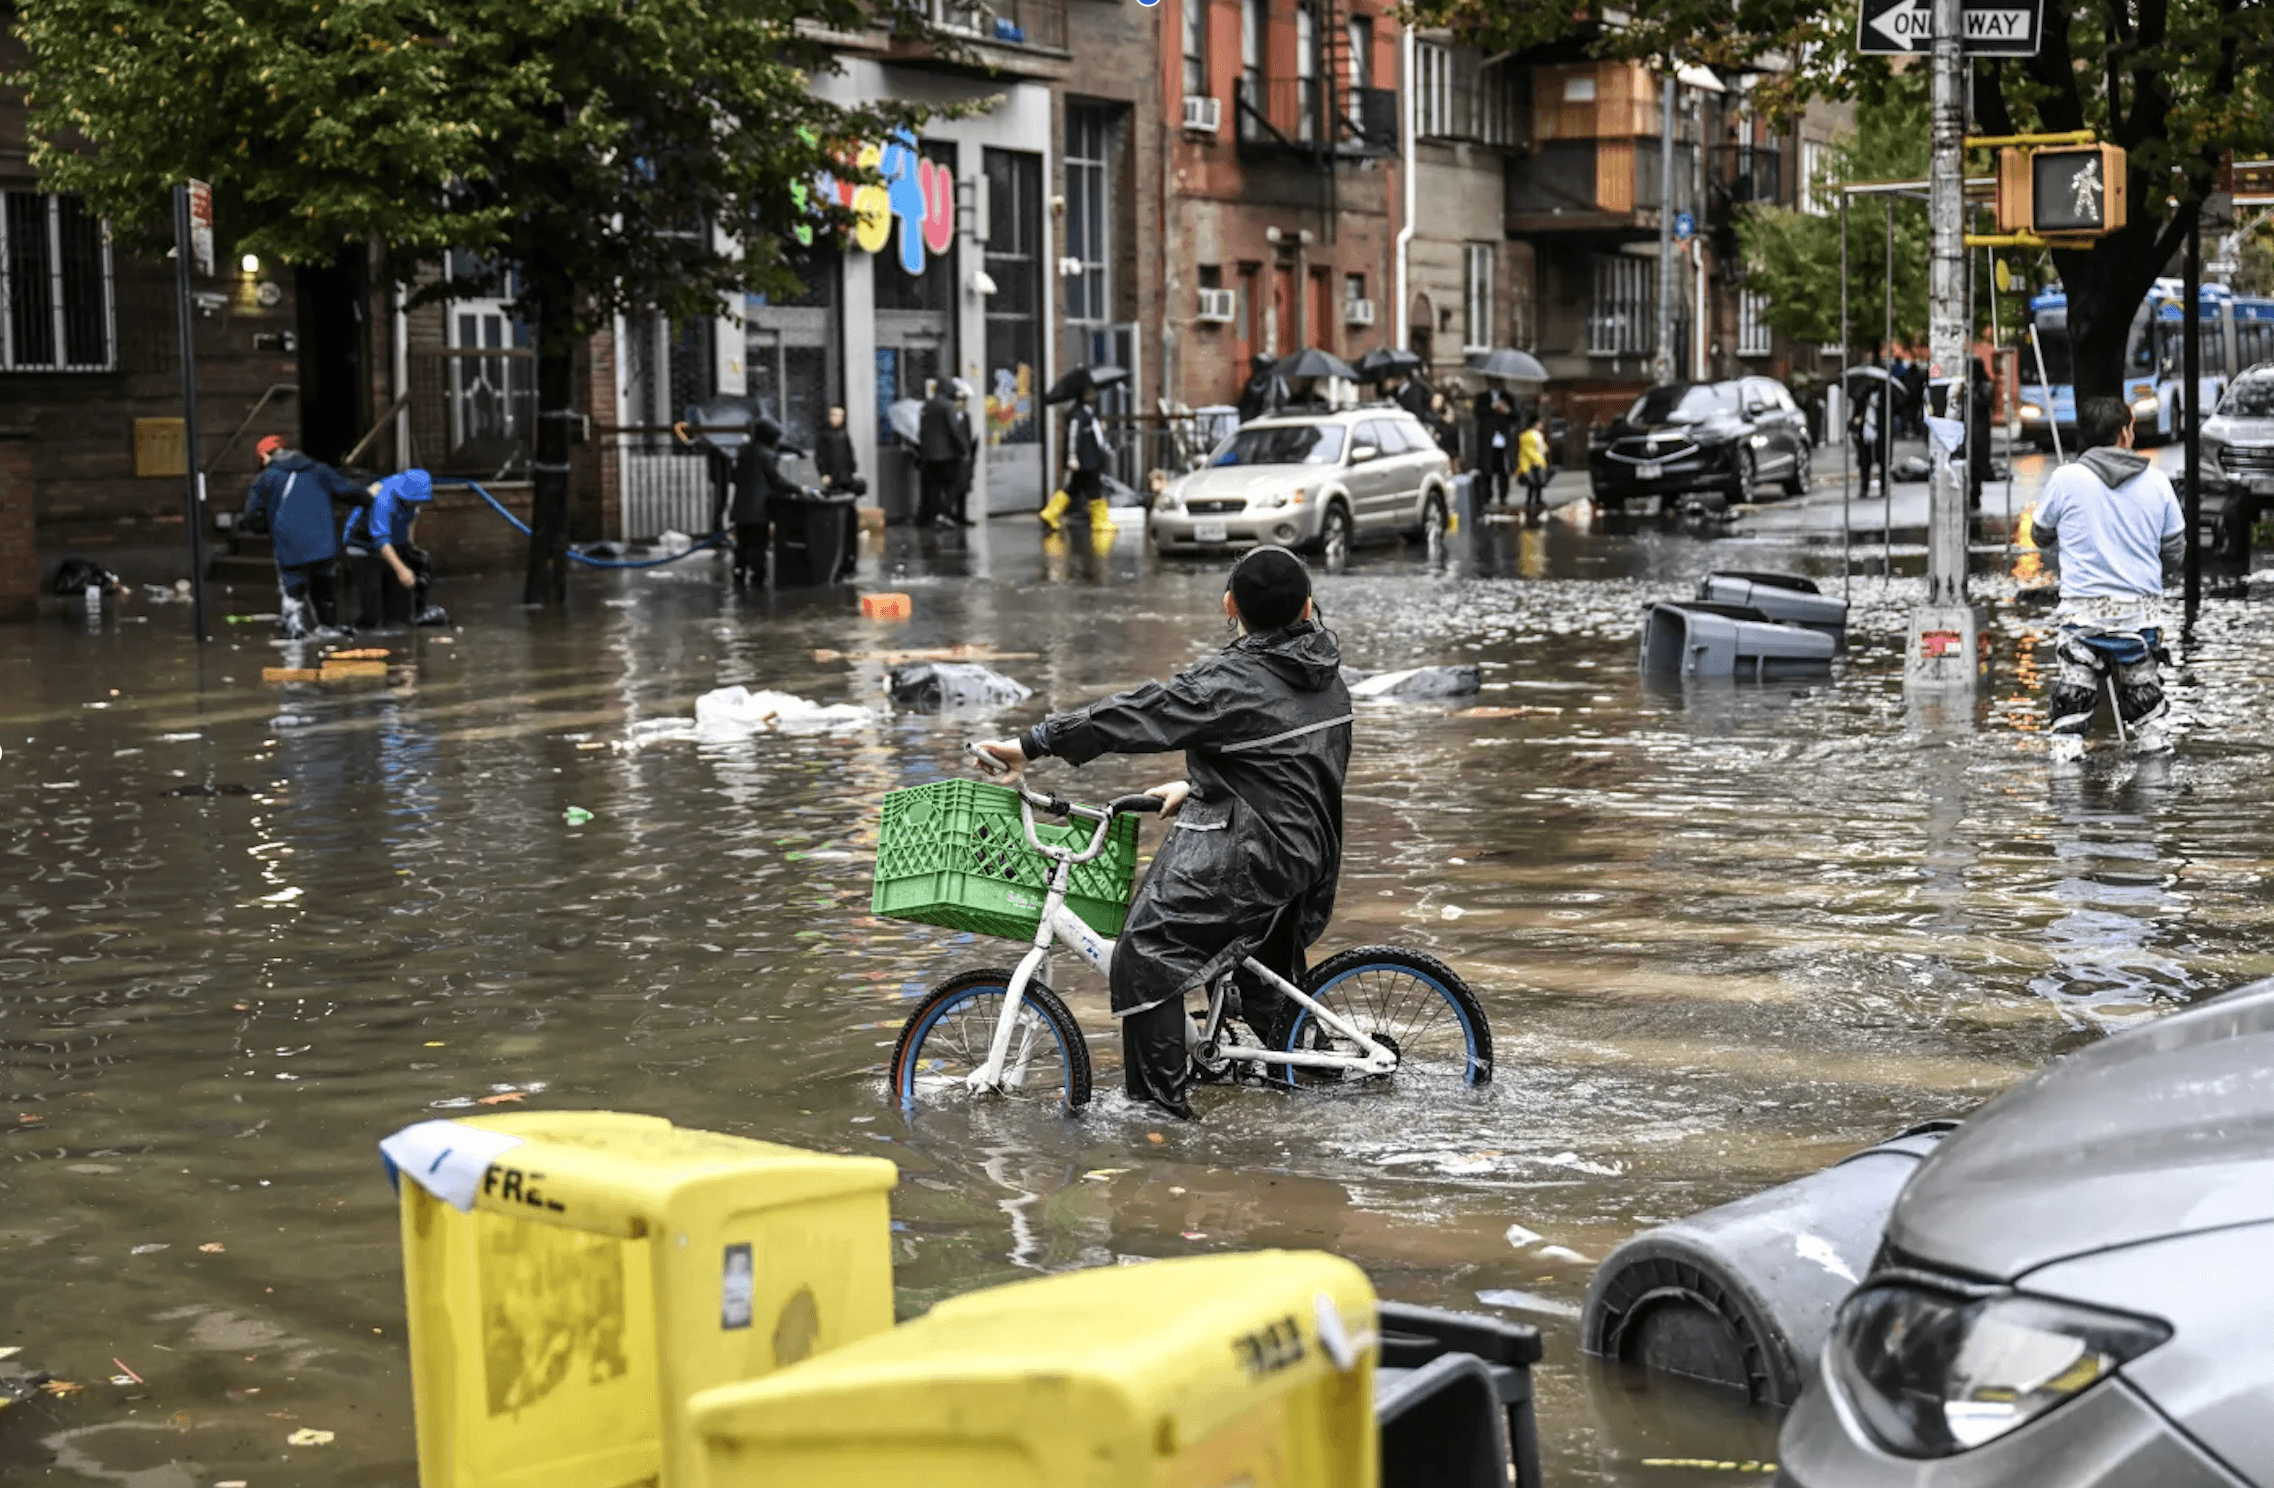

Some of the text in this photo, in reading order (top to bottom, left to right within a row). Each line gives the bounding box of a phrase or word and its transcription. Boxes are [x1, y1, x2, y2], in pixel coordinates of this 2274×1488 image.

[1894, 13, 2020, 35] ON WAY
[483, 1164, 566, 1212] FRE
